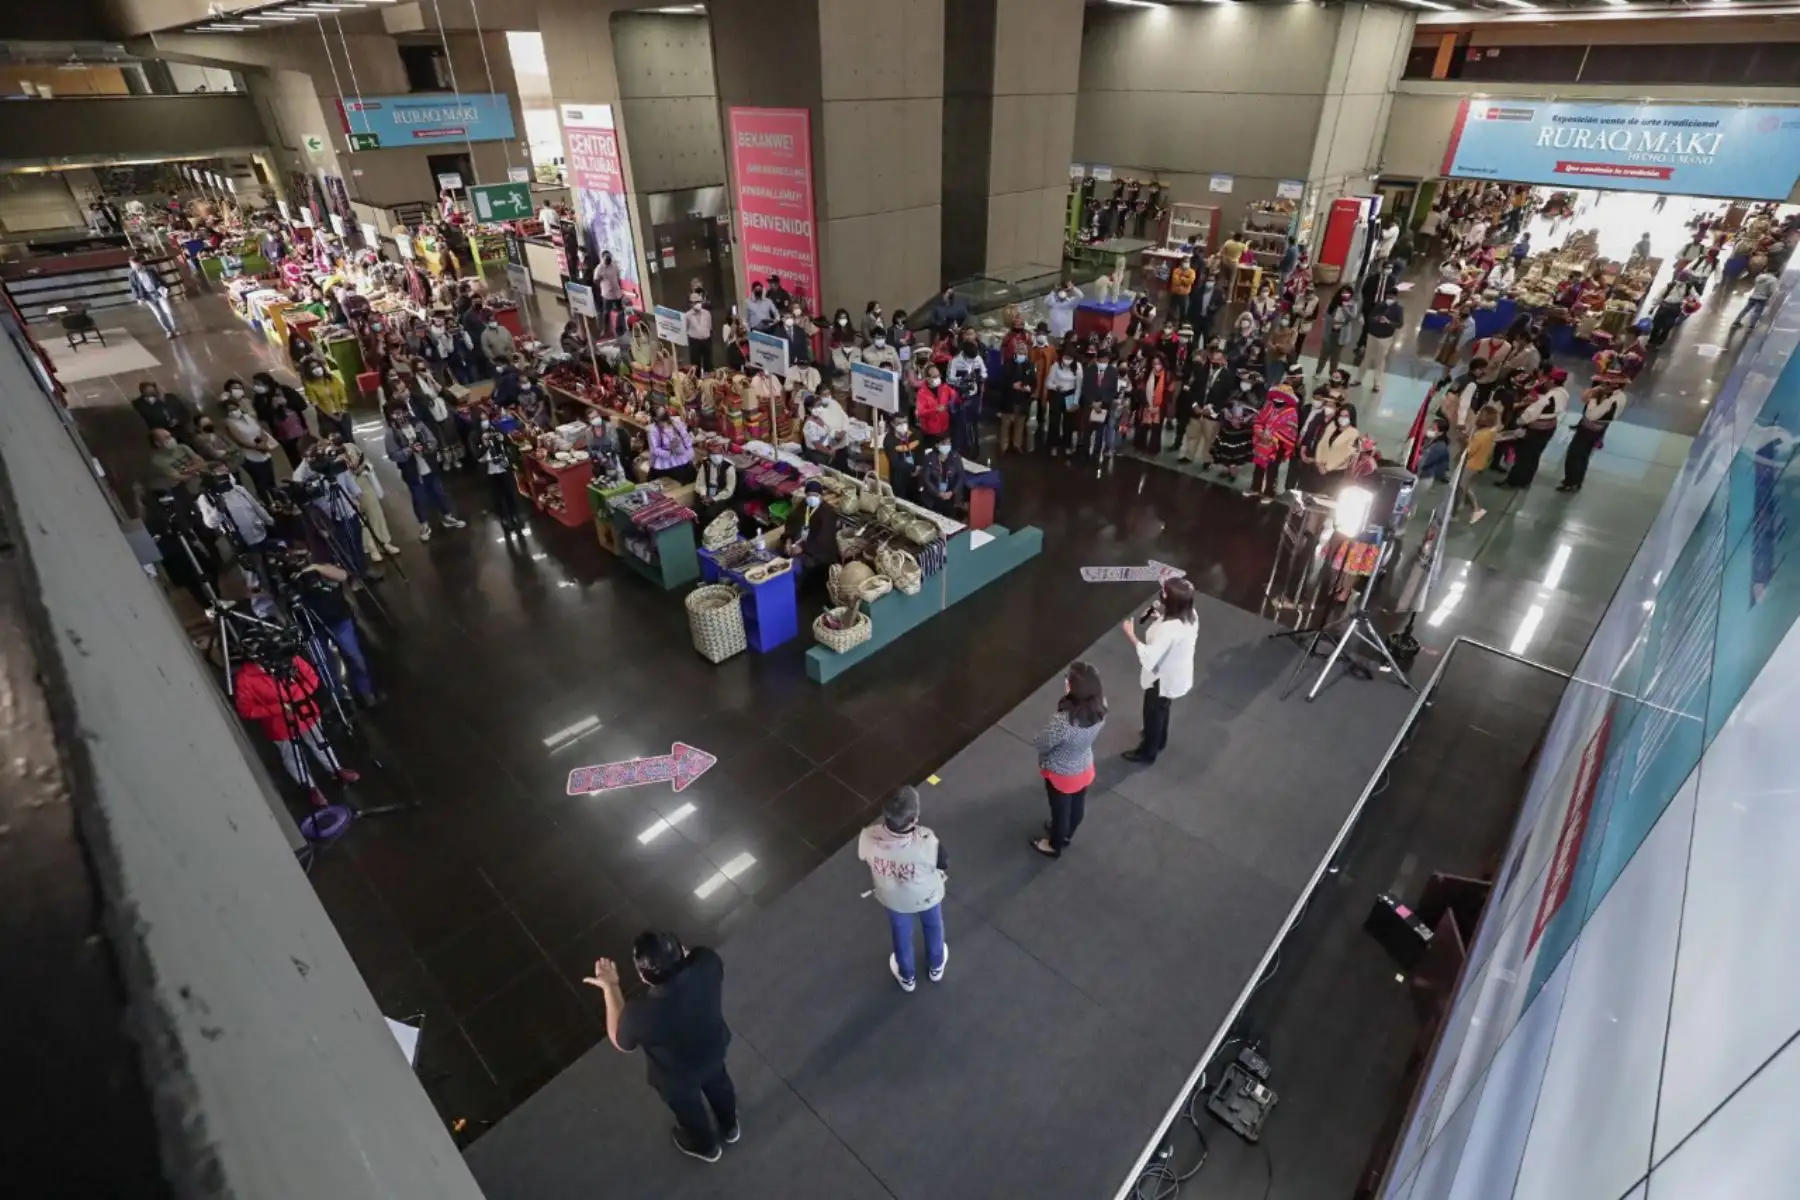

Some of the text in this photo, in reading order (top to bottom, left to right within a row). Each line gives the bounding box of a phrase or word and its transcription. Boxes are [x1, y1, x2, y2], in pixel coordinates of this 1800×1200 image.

[392, 106, 479, 124] RURAQ MAKI
[1663, 118, 1720, 128] tradicional
[568, 133, 616, 156] CENTRO
[1535, 126, 1724, 156] RURAQ MAKI
[573, 154, 619, 174] CULTURAL
[742, 211, 811, 237] BIENVENIDO
